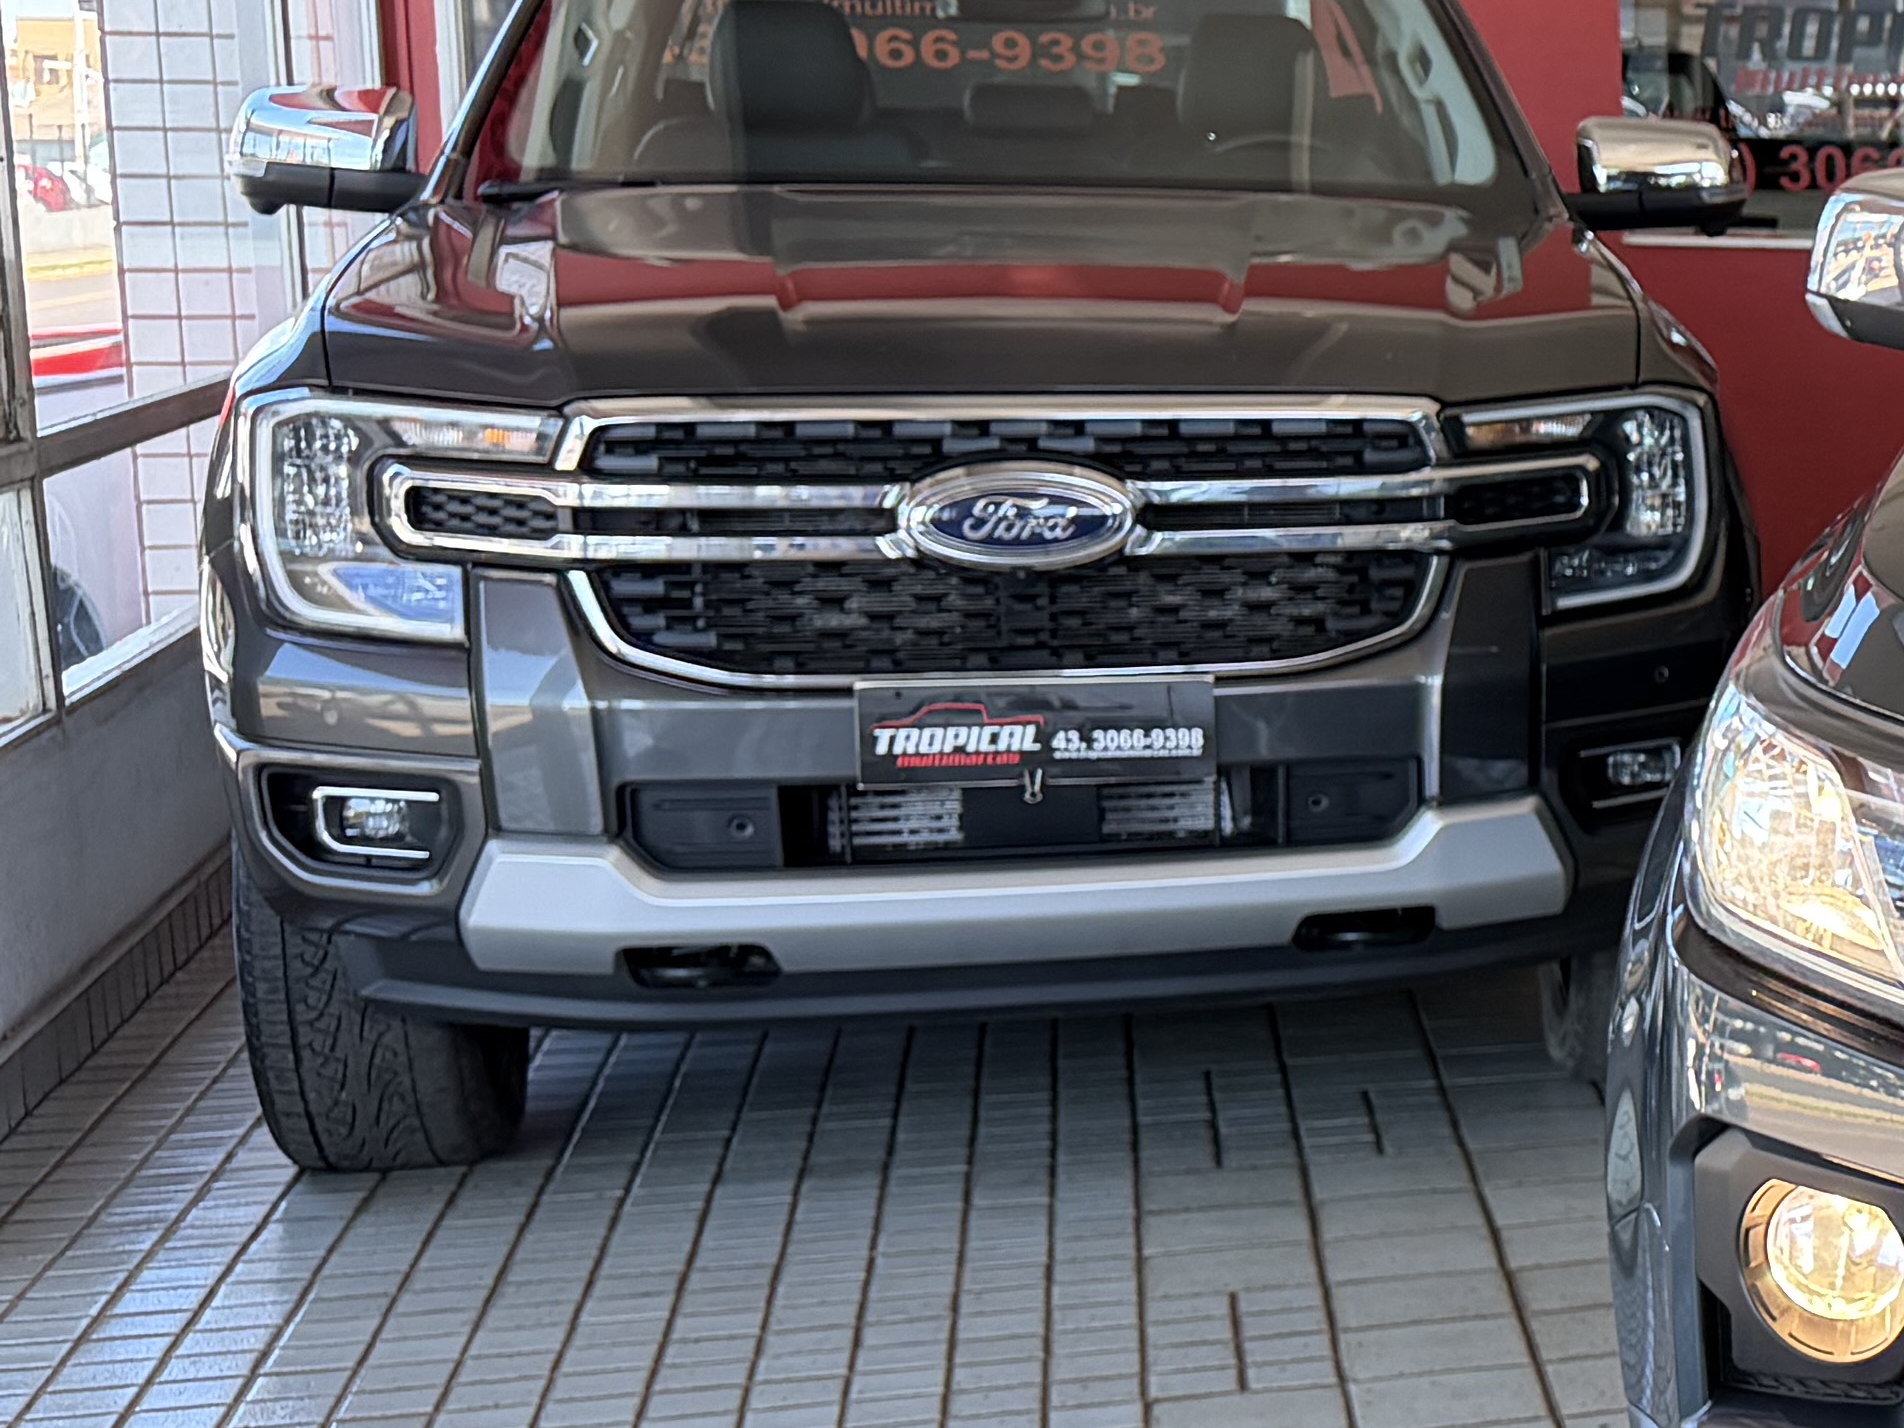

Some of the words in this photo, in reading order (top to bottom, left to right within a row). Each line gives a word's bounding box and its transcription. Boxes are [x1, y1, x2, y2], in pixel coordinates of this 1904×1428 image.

[852, 27, 1166, 73] 66-9398
[962, 494, 1076, 541] Ford
[872, 724, 1042, 756] TROPICAL
[1092, 727, 1205, 750] 3066-9398
